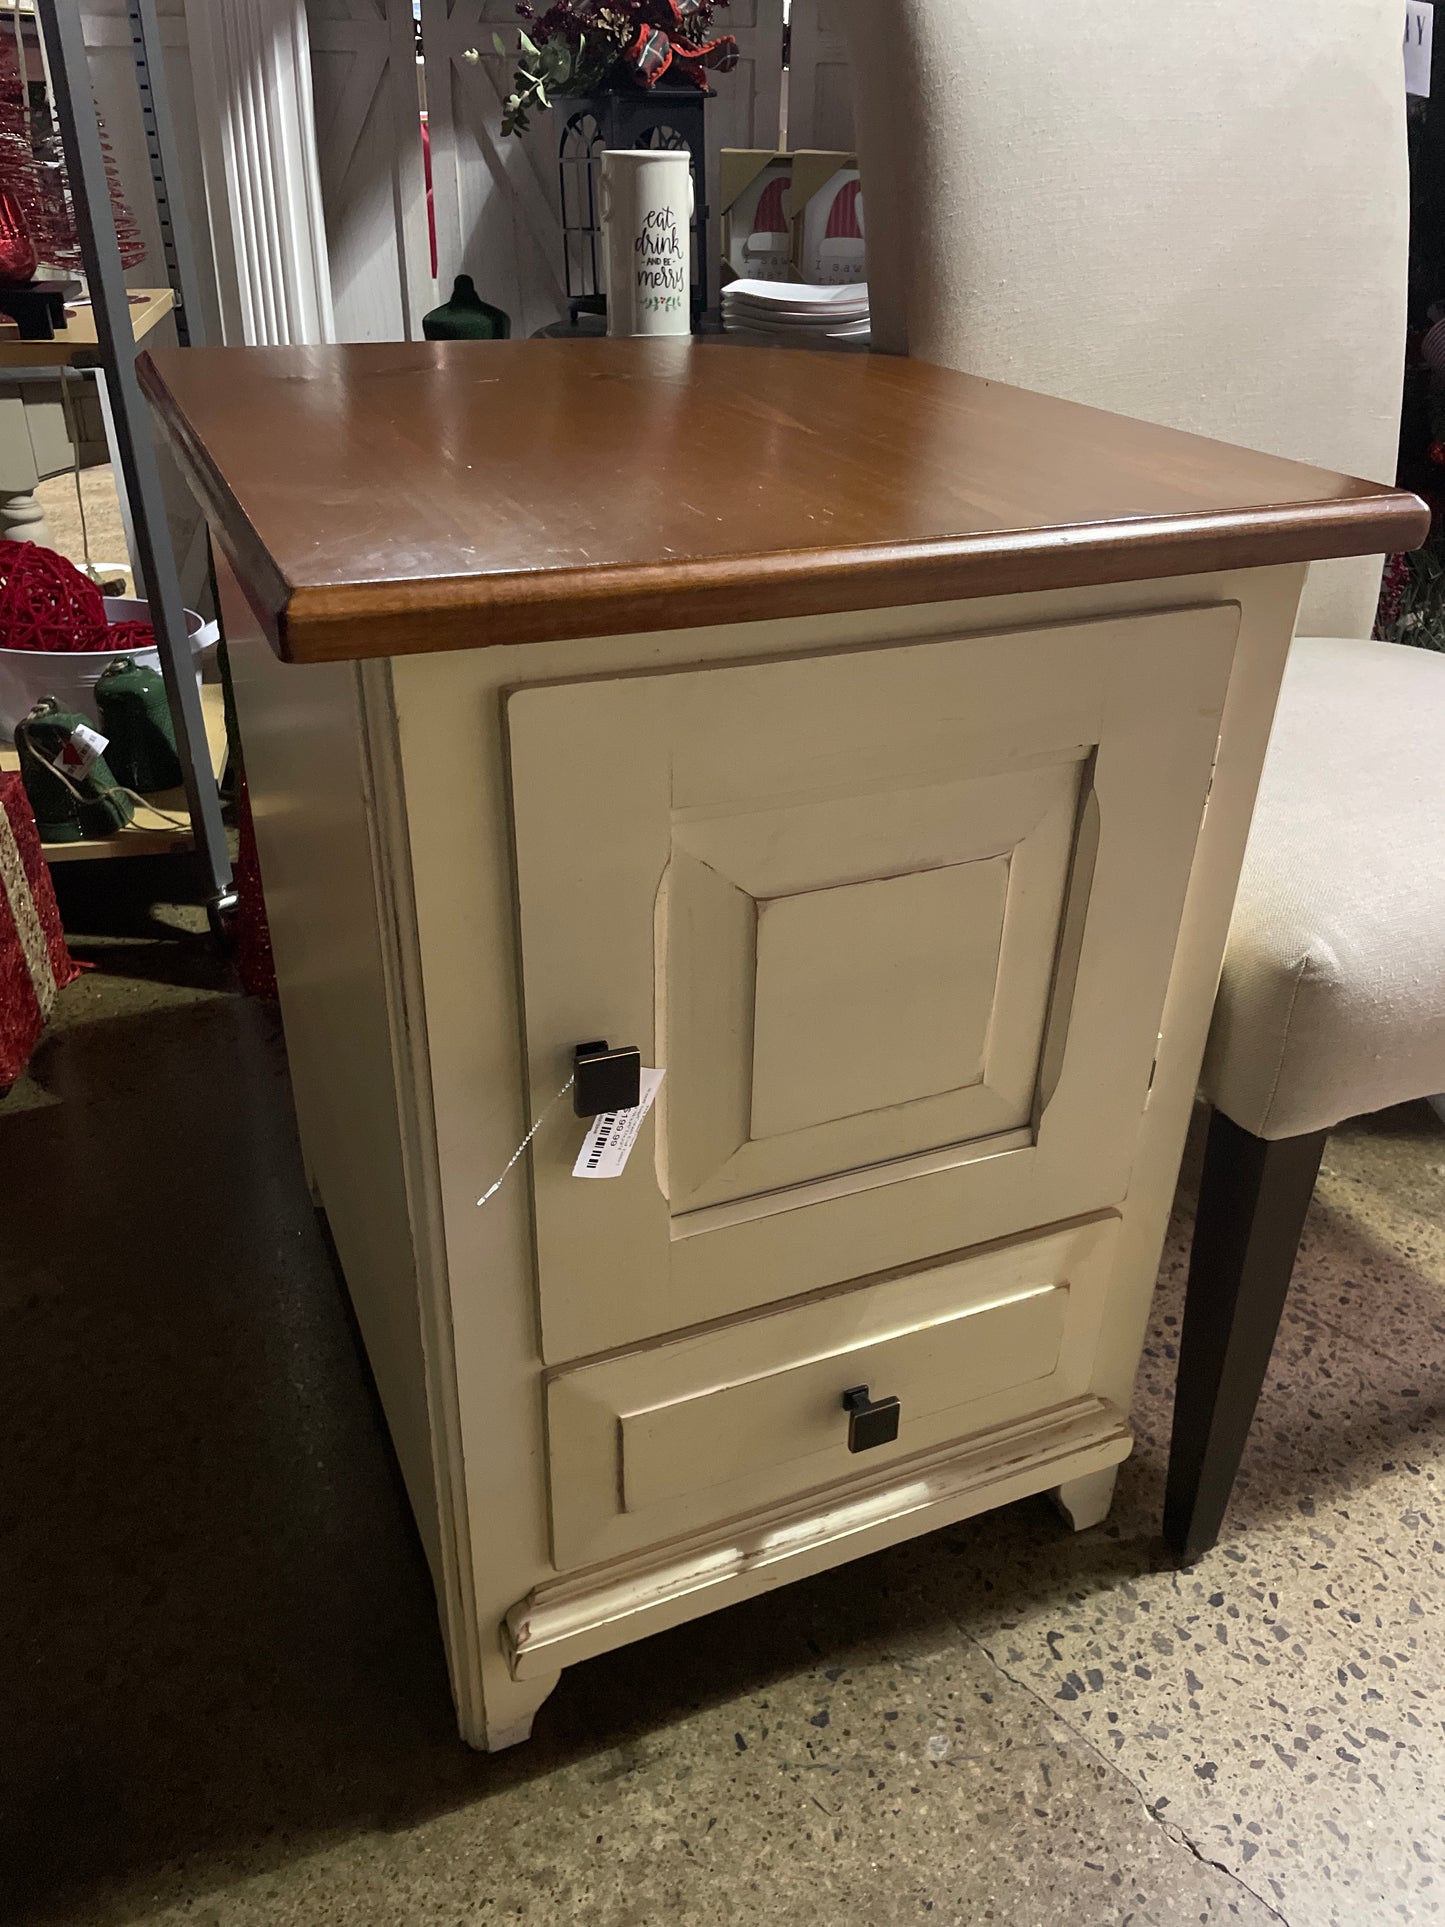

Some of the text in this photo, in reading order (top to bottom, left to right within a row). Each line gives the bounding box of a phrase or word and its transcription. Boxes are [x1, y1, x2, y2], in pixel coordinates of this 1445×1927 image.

[642, 206, 676, 231] eat
[634, 227, 684, 259] drink
[815, 259, 863, 273] I saw
[637, 266, 684, 292] merry
